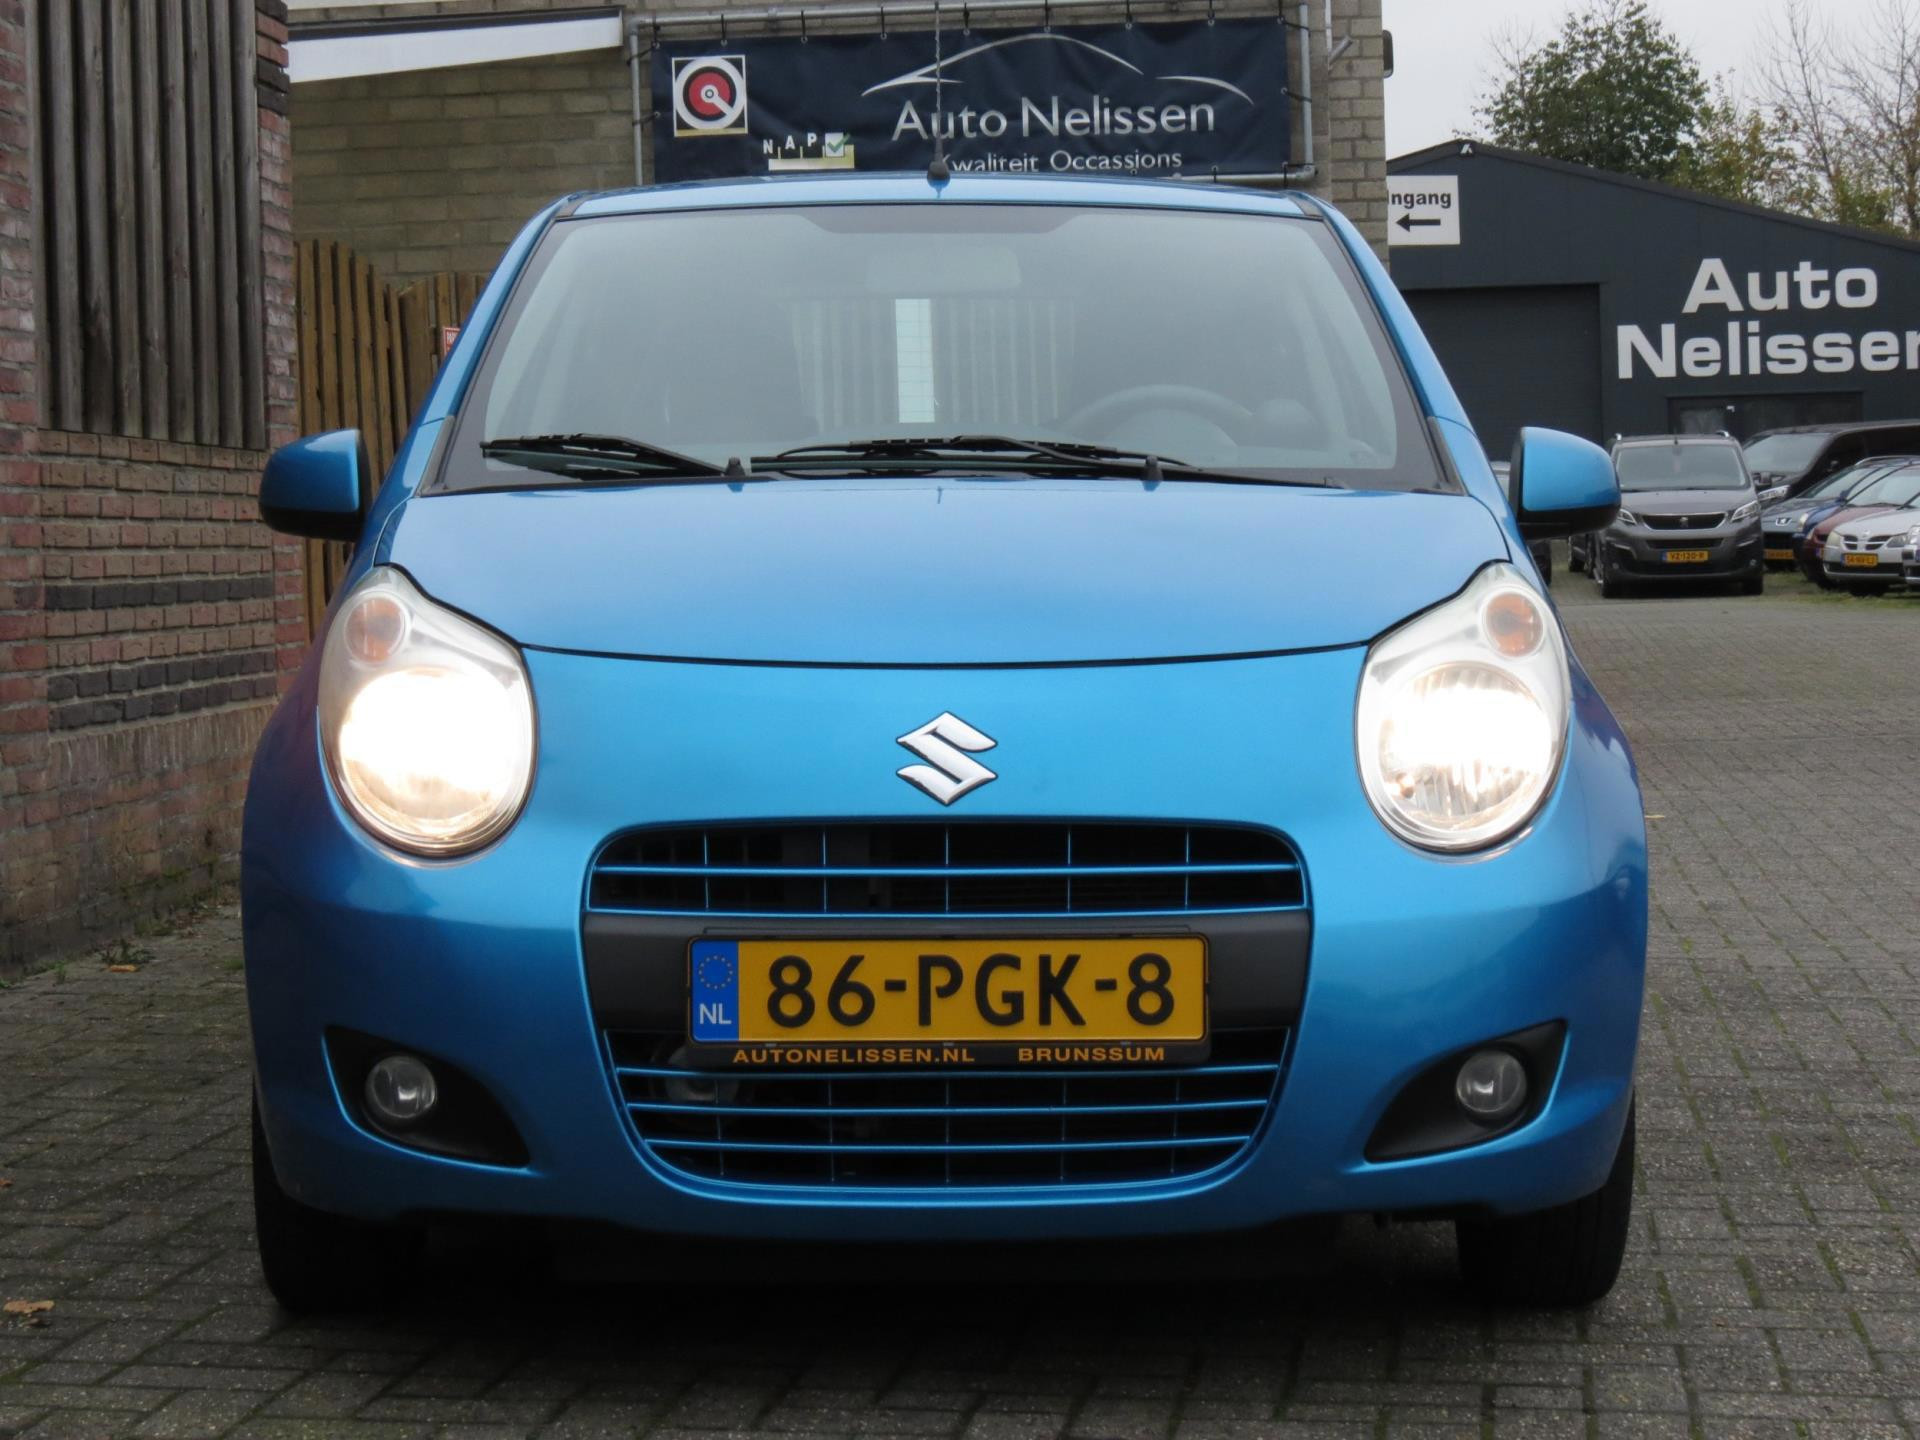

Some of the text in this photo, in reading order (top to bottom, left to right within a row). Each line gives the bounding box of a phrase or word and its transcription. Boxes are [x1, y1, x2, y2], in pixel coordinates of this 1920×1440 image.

[891, 96, 1215, 141] Auto Nelissen
[942, 149, 1183, 173] waliteit Occassions
[1387, 190, 1452, 210] ngang
[1682, 257, 1879, 314] Auto
[766, 953, 1175, 1028] 86-PGK-8
[699, 1003, 732, 1025] NL
[733, 1046, 1165, 1063] AUTONELISSEN.NL BRUNSSUM
